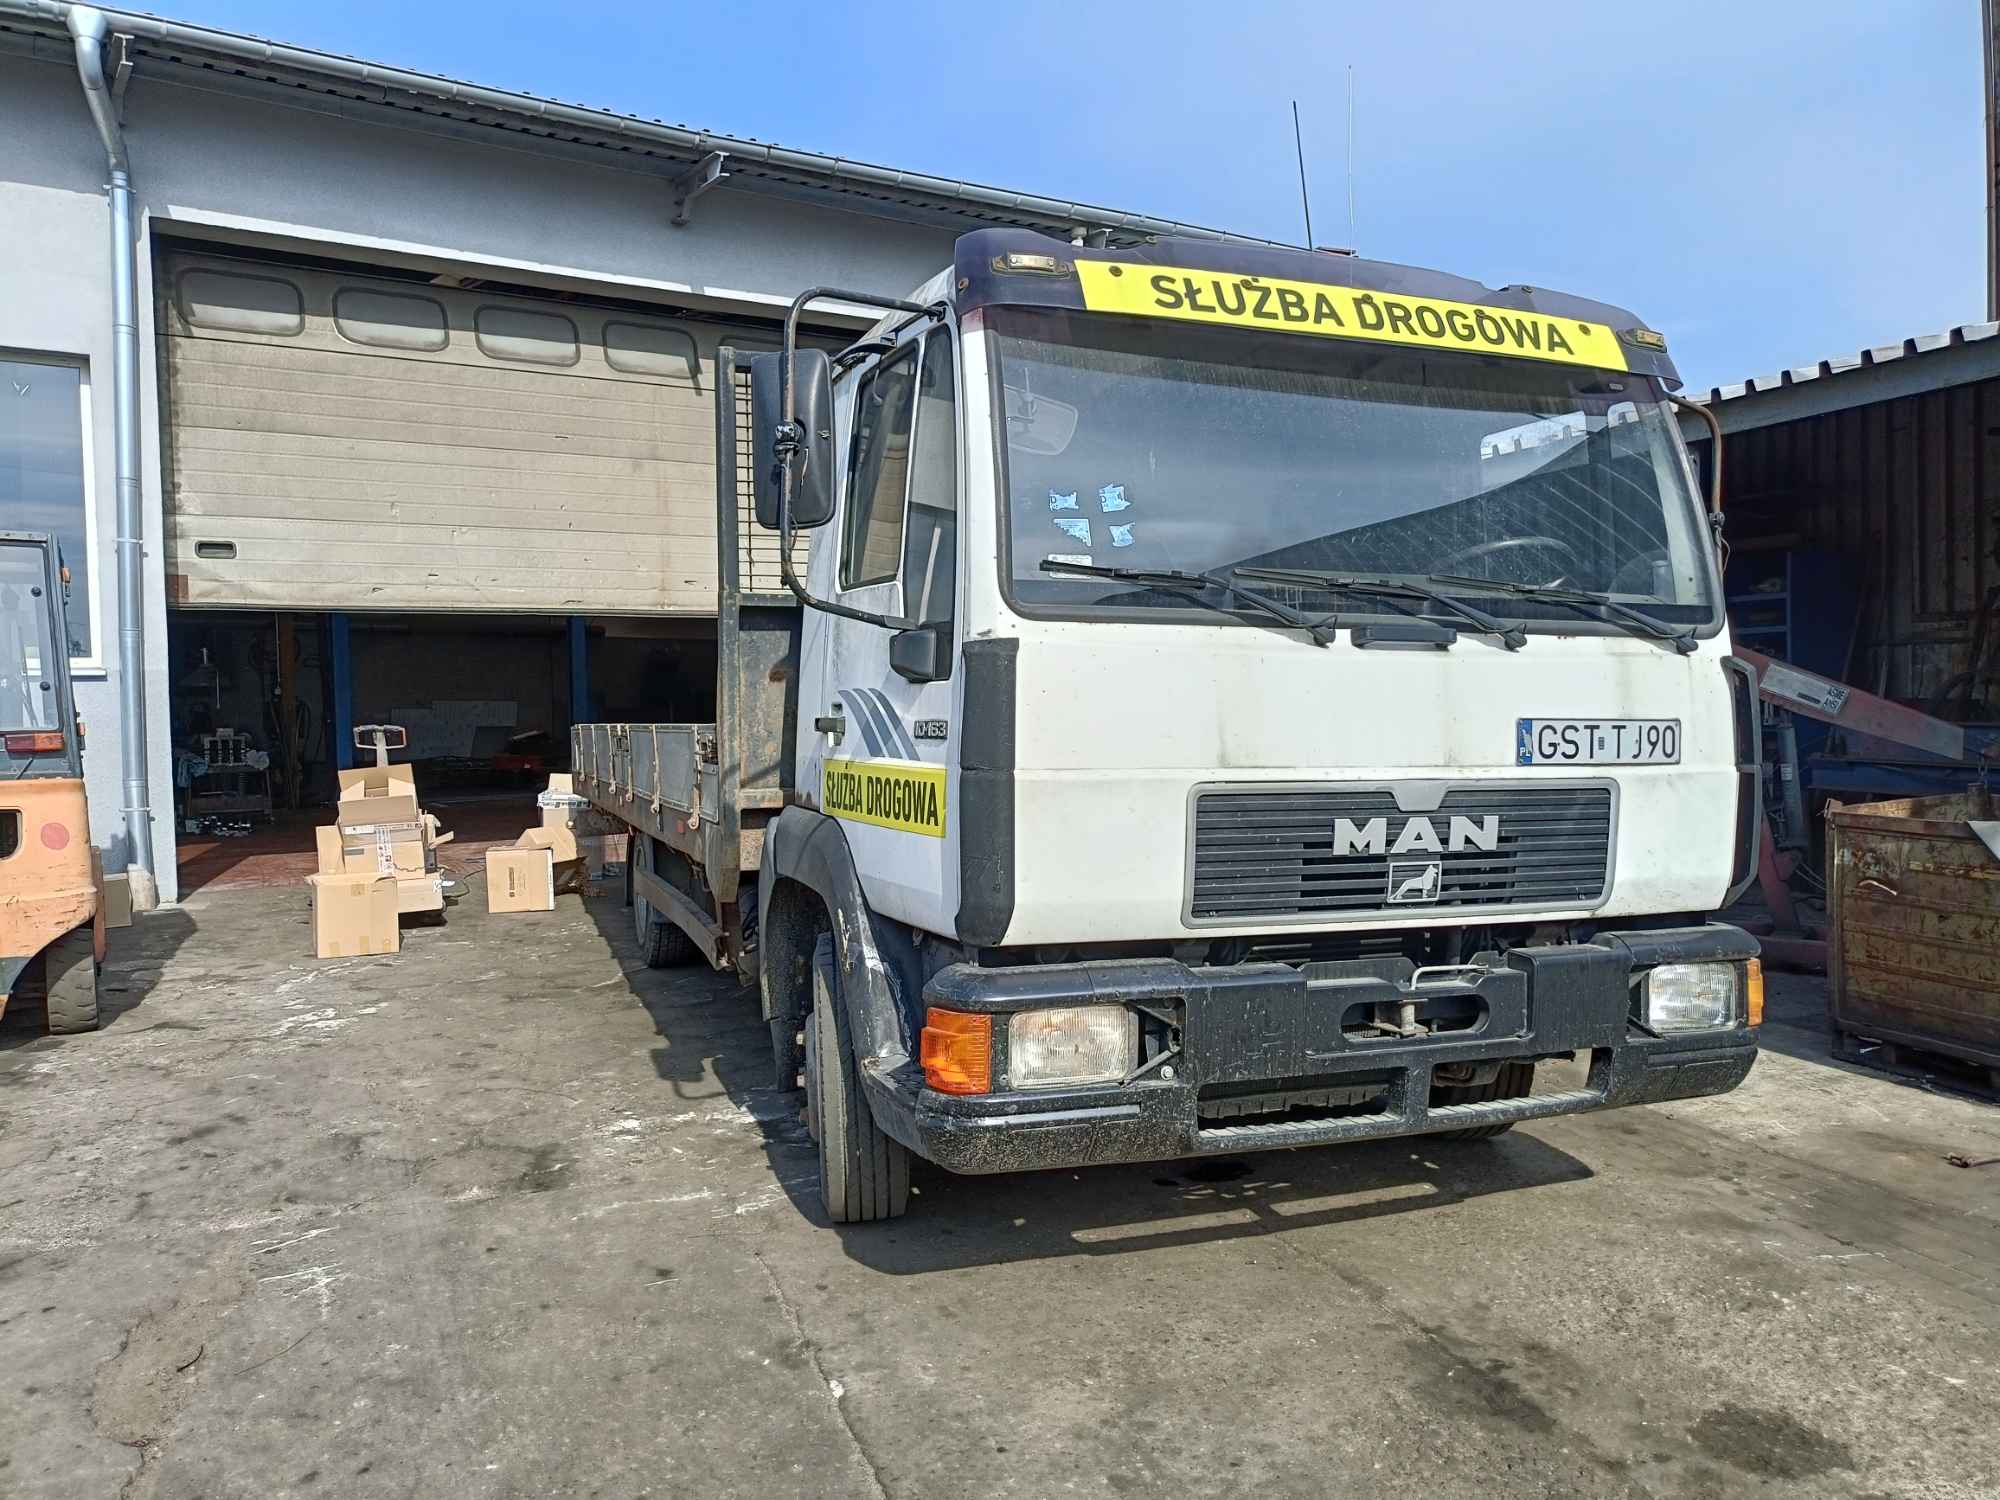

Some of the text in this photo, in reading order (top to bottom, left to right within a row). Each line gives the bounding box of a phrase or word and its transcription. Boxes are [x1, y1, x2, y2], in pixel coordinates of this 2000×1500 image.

[1150, 275, 1575, 356] SŁUŻBA DROGOWA
[1538, 724, 1676, 760] GST TJ90
[826, 763, 939, 827] SŁUŻBA DROGOWA
[1332, 815, 1500, 856] MAN
